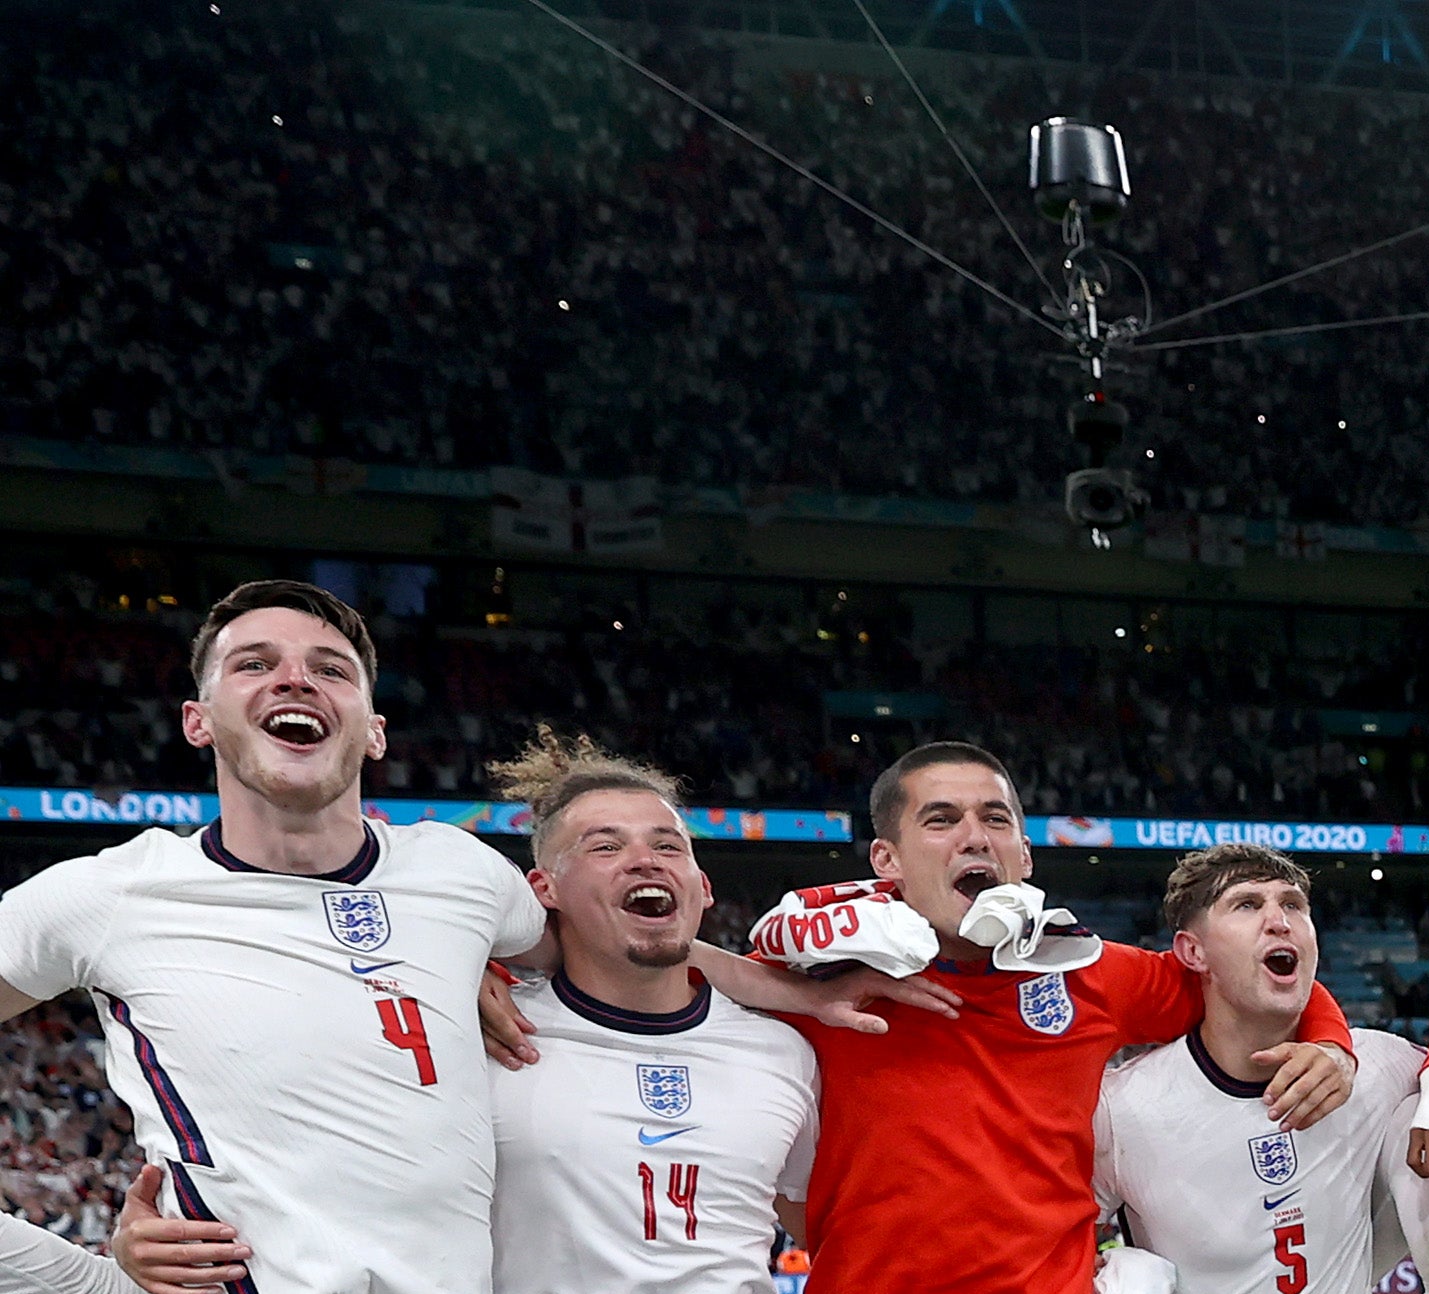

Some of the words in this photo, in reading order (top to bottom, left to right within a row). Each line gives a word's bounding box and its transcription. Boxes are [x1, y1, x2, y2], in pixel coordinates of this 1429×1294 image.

[1136, 820, 1212, 847] UEFA
[1214, 823, 1293, 849] EURO
[1294, 825, 1367, 851] 2020
[375, 997, 438, 1086] 4
[638, 1161, 700, 1240] 14
